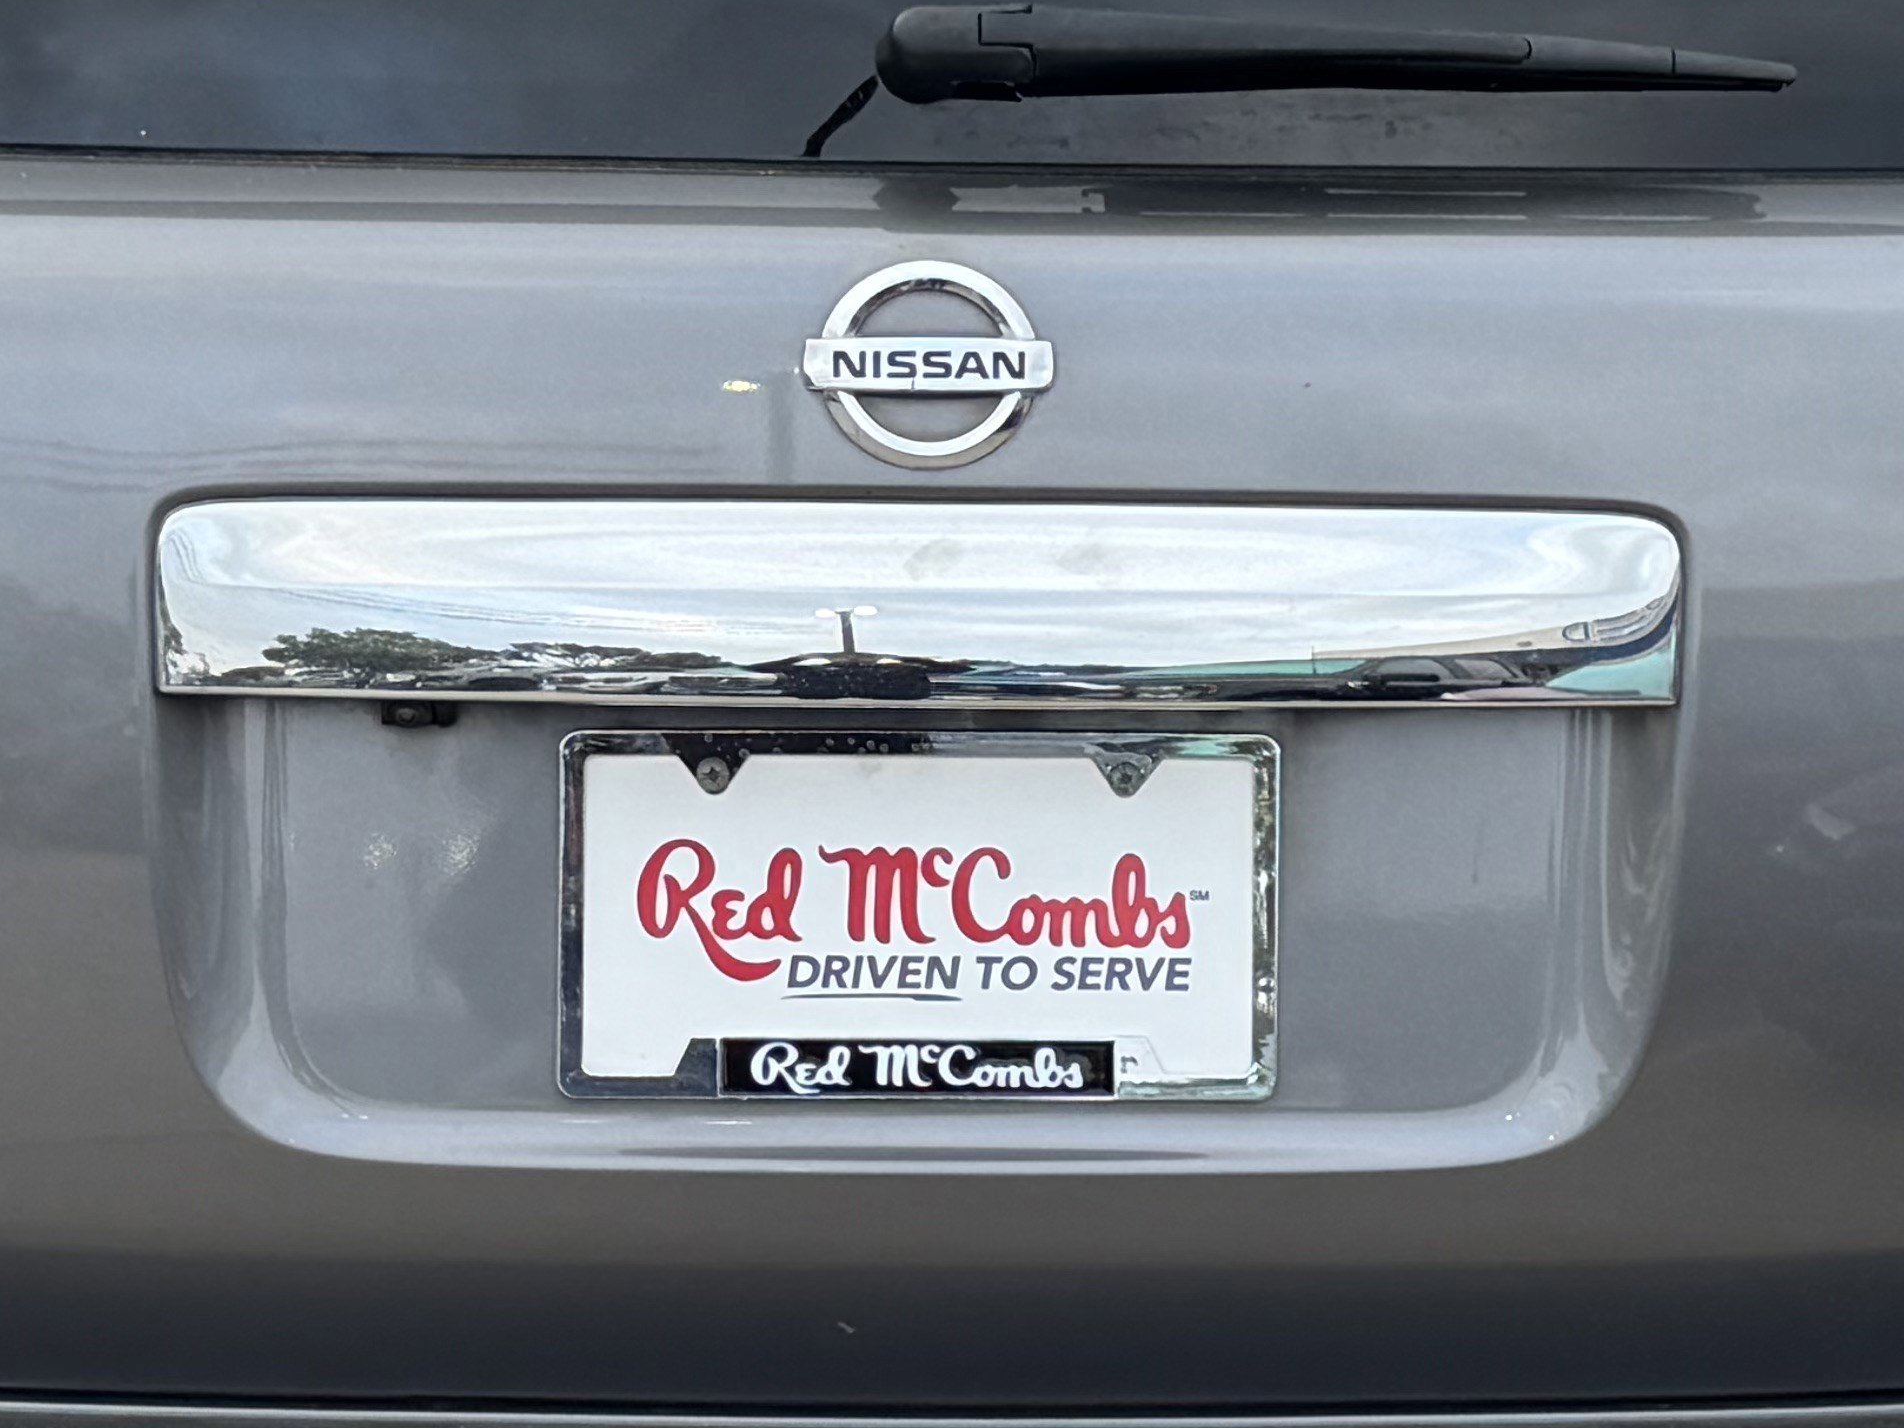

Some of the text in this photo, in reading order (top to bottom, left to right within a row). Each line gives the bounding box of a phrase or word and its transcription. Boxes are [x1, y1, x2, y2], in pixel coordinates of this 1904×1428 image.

[832, 350, 1026, 380] NISSAN
[636, 838, 802, 982] Red
[817, 845, 1191, 949] McCombs
[786, 954, 1193, 992] DRIVEN TO SERVE
[750, 1042, 1085, 1095] Red McCombs
